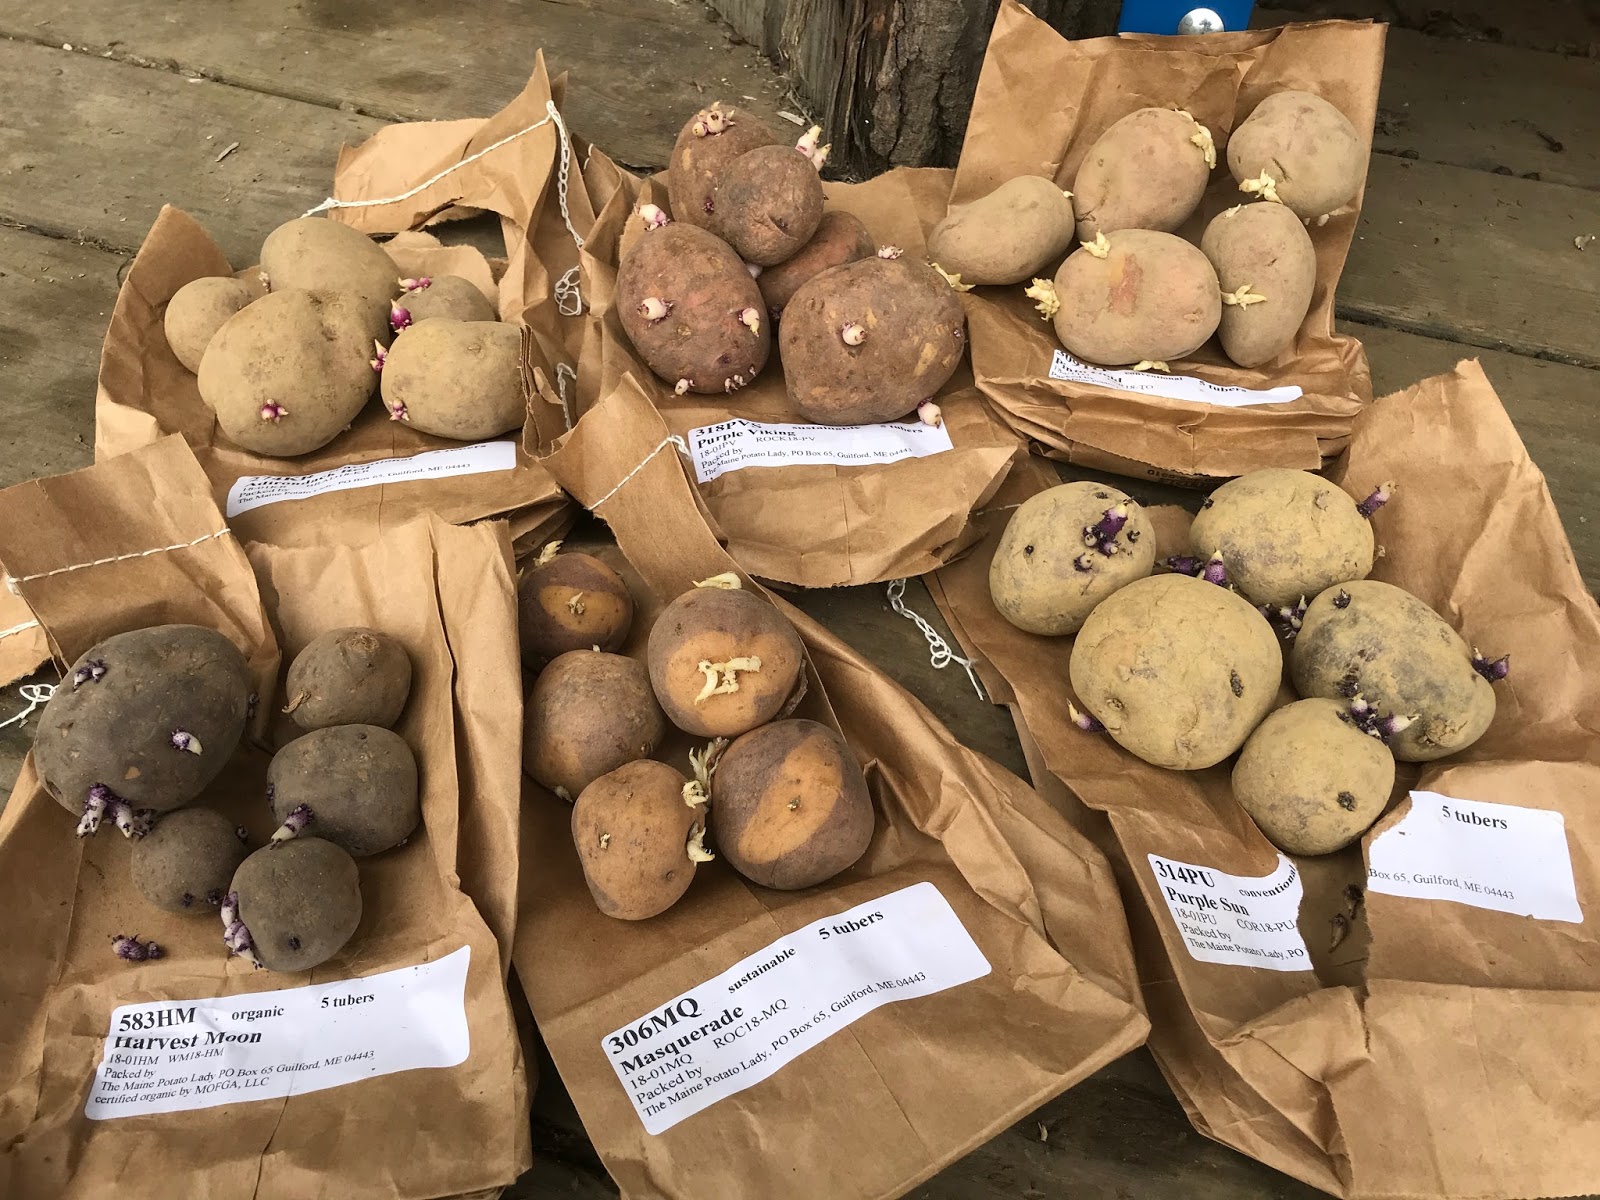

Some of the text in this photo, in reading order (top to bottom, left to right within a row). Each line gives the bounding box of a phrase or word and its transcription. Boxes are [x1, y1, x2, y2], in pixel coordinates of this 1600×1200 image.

[1208, 384, 1247, 393] tubers
[697, 429, 796, 449] Purple Viking
[700, 440, 737, 459] 18-01PV
[701, 447, 743, 469] Packed by
[703, 467, 716, 476] The
[716, 458, 740, 468] Maine
[741, 452, 766, 460] Potato
[767, 450, 789, 458] Lady,
[255, 492, 282, 500] Maine
[1442, 805, 1508, 830] 5 tubers
[1155, 860, 1297, 897] 314PU conventional
[1369, 868, 1515, 900] Box 65, Guilford, ME 04443
[1165, 886, 1250, 917] Purple Sun
[1175, 907, 1296, 933] 18-01PU COR18-PU
[1180, 922, 1232, 942] Packed by
[1187, 937, 1305, 960] The Maine Potato Lady, PO
[608, 909, 884, 1055] 306MQ sustainable 5 tubers
[119, 993, 375, 1032] 583HM organic 5 tubers
[114, 1031, 262, 1050] Harvest Moon
[620, 1005, 744, 1075] Masquerade
[630, 998, 789, 1090] 18-01MQ ROC18-MQ
[643, 971, 926, 1118] The Maine Potato Lady, PO Box 65, Guilford, ME 04443
[109, 1047, 225, 1066] 18-01HM WM18-HM
[101, 1081, 120, 1092] The
[123, 1080, 154, 1091] Maine
[157, 1076, 188, 1088] Potato
[190, 1073, 216, 1083] Lady
[218, 1068, 235, 1078] PO
[237, 1068, 258, 1077] Box
[260, 1066, 273, 1074] 65
[324, 1055, 342, 1067] ME
[344, 1050, 375, 1063] 04443
[104, 1068, 156, 1079] Packed by
[94, 1077, 270, 1105] certified organic by MOFGA, LLC
[636, 1066, 703, 1105] Packed by
